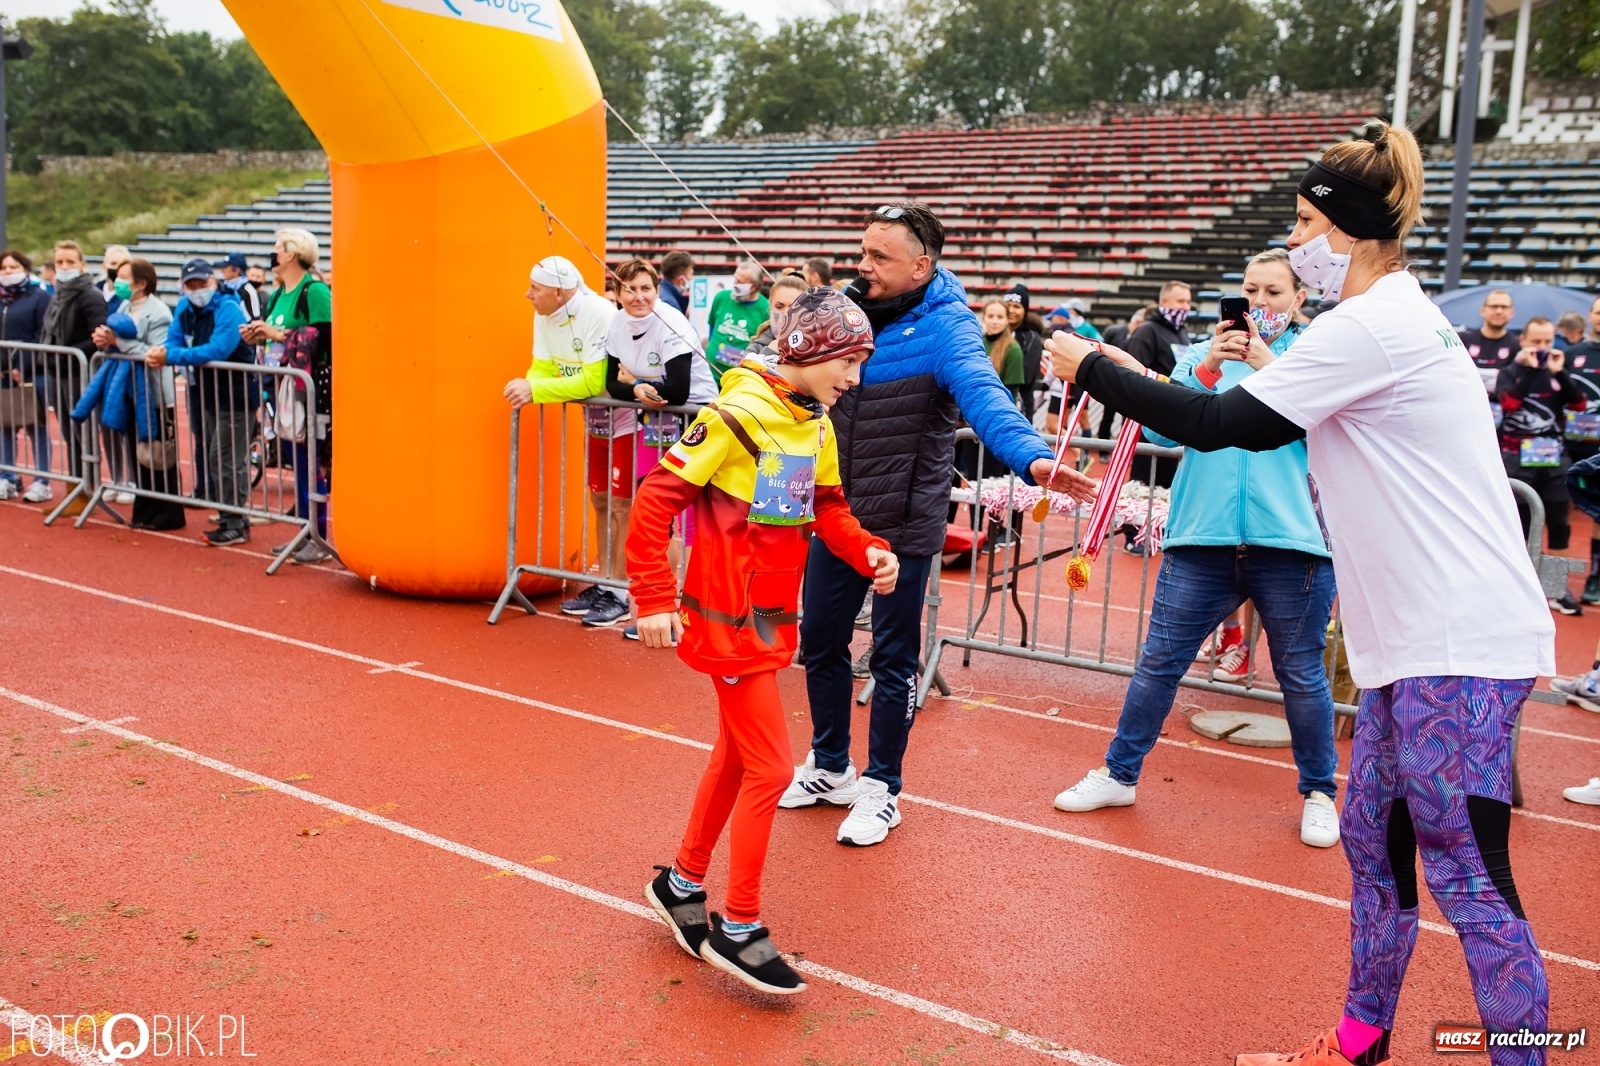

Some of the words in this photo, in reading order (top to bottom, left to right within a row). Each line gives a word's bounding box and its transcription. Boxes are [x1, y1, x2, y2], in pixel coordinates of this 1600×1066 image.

[1311, 184, 1333, 197] 4F
[792, 334, 799, 345] B
[768, 478, 787, 489] BIEG
[790, 481, 803, 490] DLA
